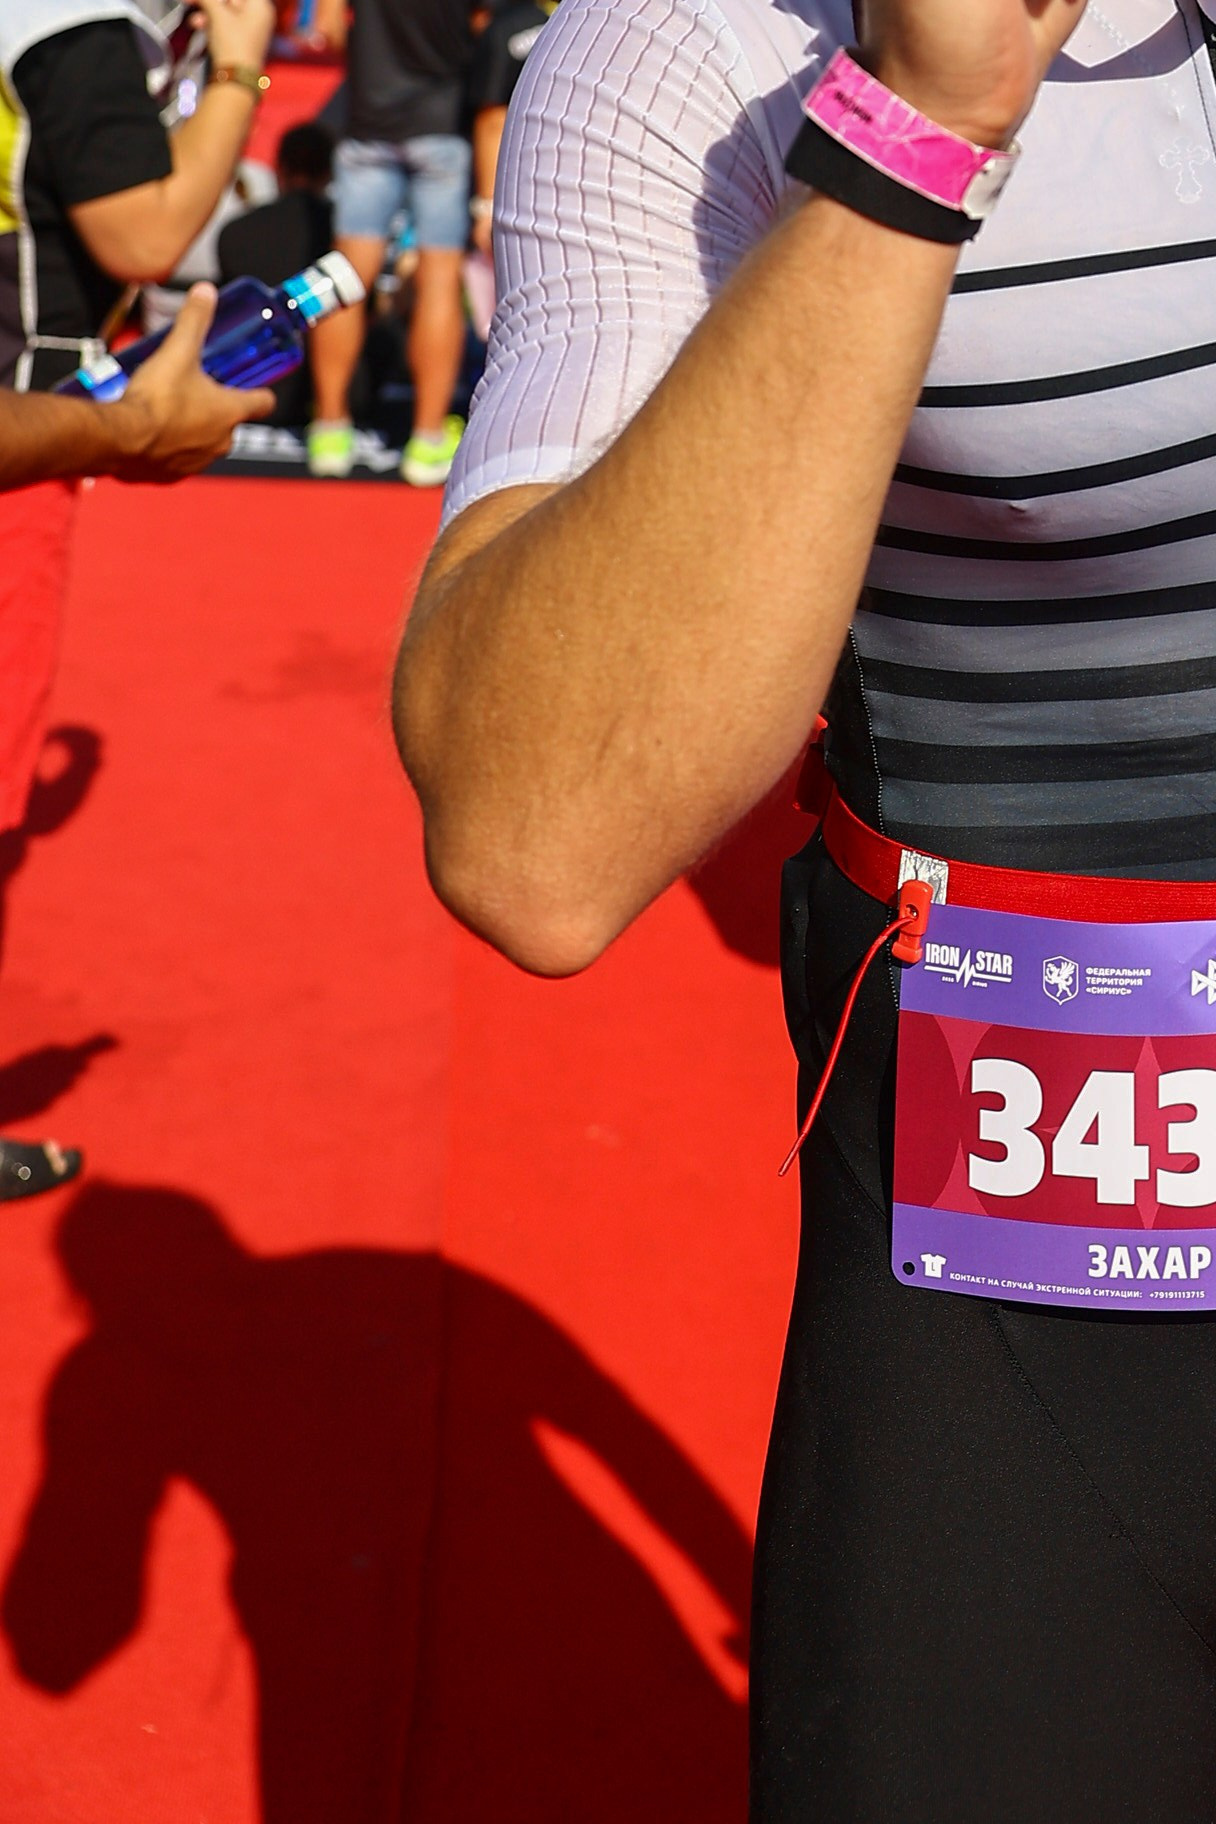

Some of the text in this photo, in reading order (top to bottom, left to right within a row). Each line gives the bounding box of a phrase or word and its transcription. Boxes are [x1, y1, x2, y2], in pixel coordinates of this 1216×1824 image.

[925, 942, 1013, 975] IRON STAR
[1085, 967, 1151, 978] ФЕДЕРАЛЬНАЯ
[1085, 977, 1143, 987] ТЕРРИТОРИЯ
[1088, 1244, 1212, 1280] ЗАХАР
[949, 1272, 986, 1285] КОНТАКТ
[987, 1278, 1000, 1287] НА
[1001, 1280, 1034, 1291] СЛУЧАЙ
[1035, 1283, 1091, 1295] ЭКСТРЕННОЙ
[1093, 1288, 1142, 1298] СИТУАЦИИ:
